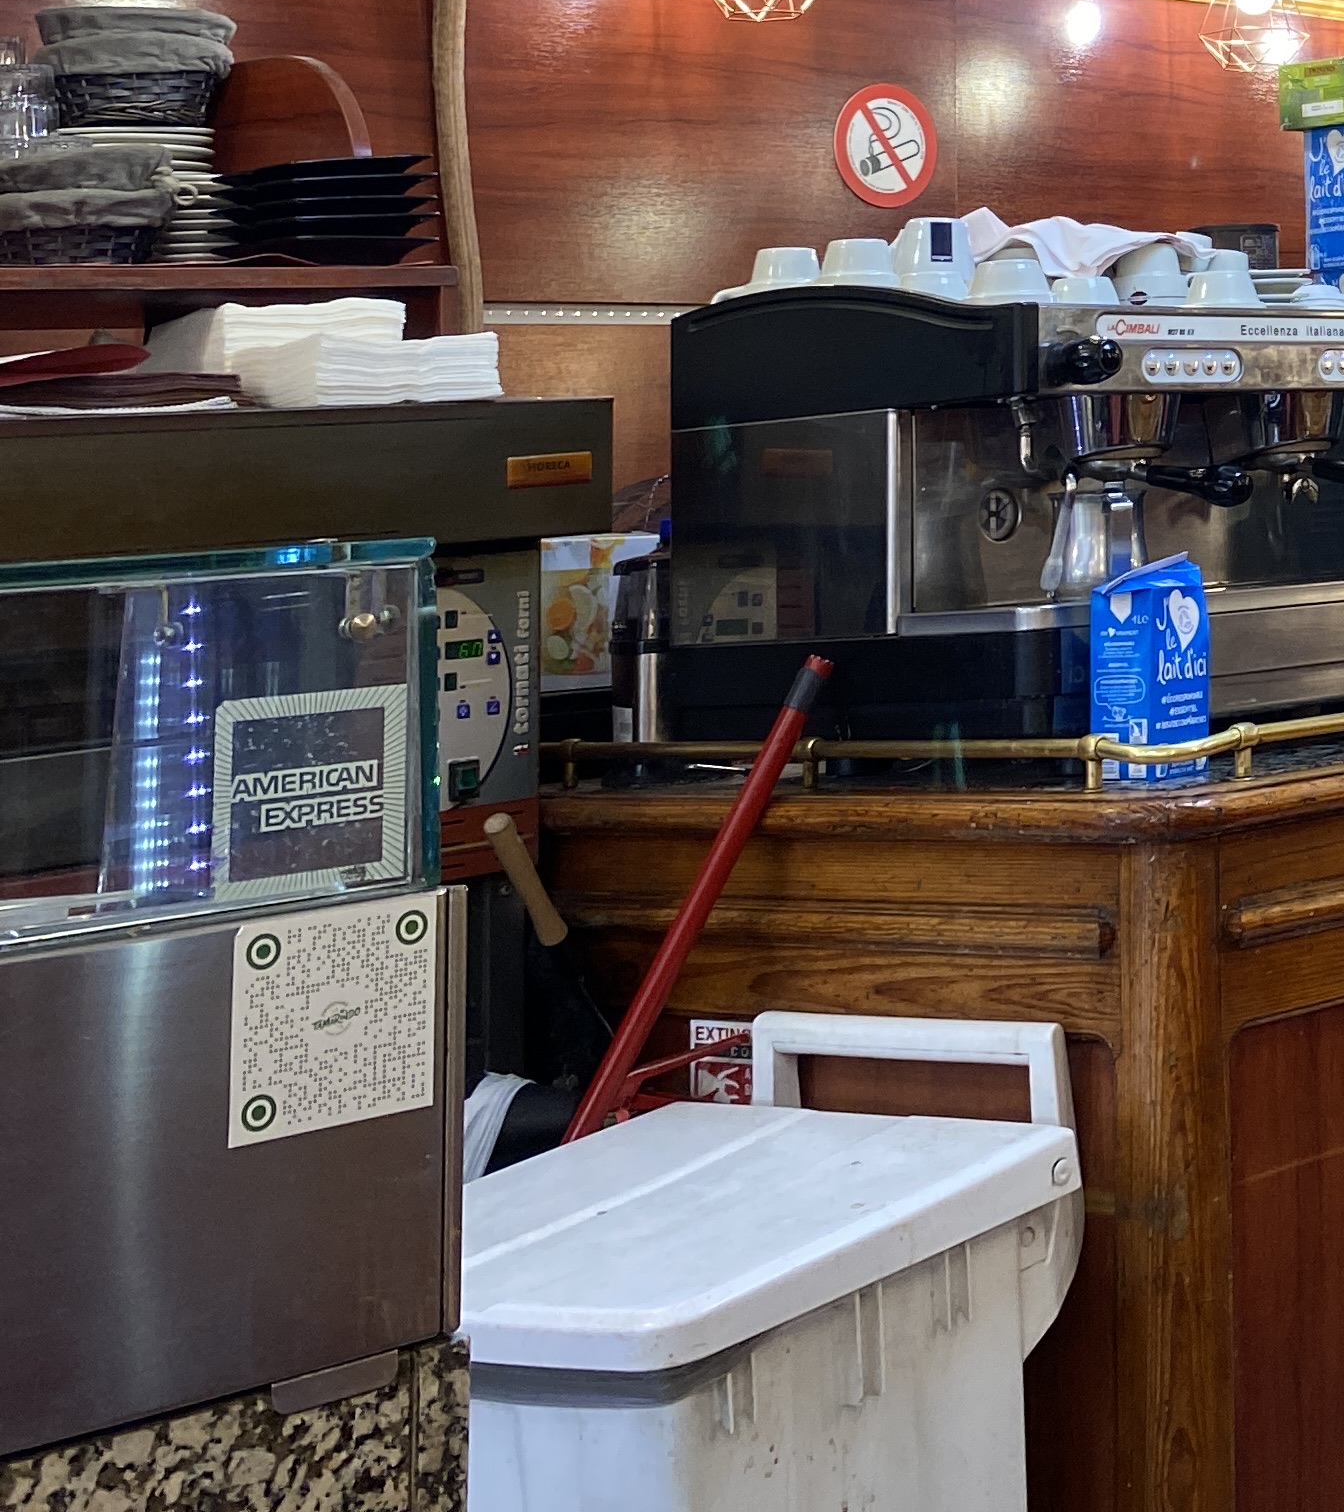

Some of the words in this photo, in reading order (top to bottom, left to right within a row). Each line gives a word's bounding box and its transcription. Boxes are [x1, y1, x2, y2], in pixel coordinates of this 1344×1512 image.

[1311, 178, 1331, 203] lait
[1116, 318, 1160, 335] CIMBALI
[1240, 324, 1298, 338] Eccellenza
[1306, 326, 1344, 338] italiana
[526, 460, 571, 472] HORECA
[517, 590, 530, 638] forni
[1157, 650, 1182, 685] lait
[1184, 648, 1207, 680] d'ici
[514, 644, 529, 735] tornati
[232, 763, 374, 799] AMERICAN
[265, 794, 384, 827] EXPRESS
